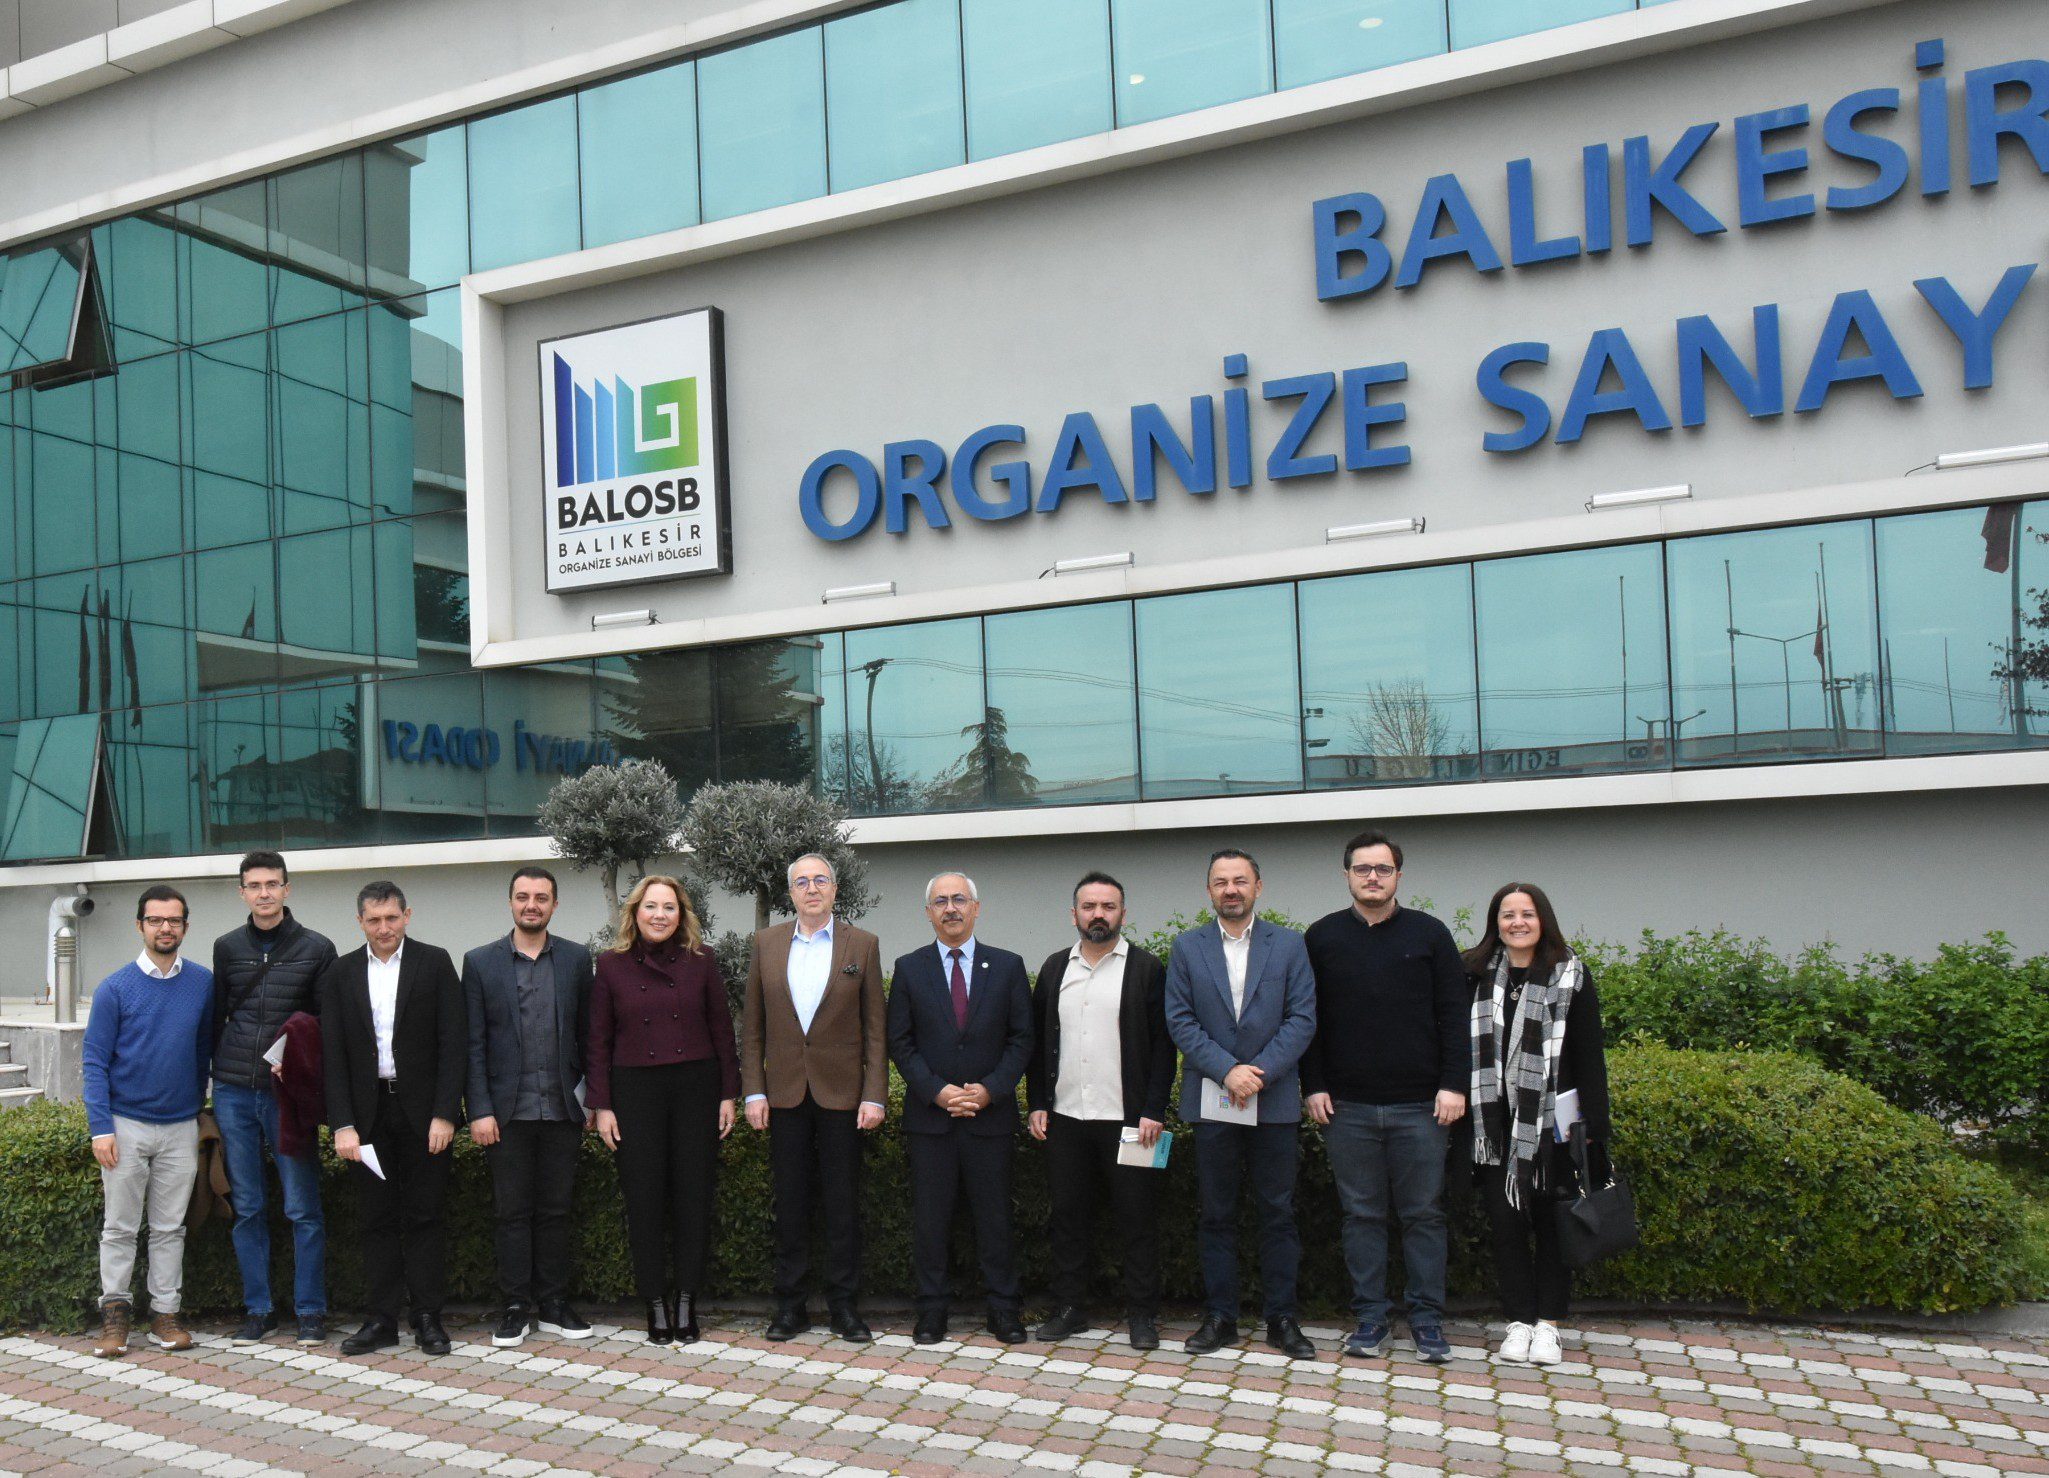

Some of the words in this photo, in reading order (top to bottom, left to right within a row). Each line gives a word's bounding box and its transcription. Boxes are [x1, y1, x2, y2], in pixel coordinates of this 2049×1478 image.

[1312, 38, 2049, 302] BALIKESİR
[799, 353, 1412, 542] ORGANİZE
[1476, 263, 2039, 453] SANAY
[558, 477, 700, 529] BALOSB
[558, 556, 612, 574] ORGANİZE
[615, 551, 653, 567] SANAYİ
[657, 543, 702, 562] BÖLGESİ
[559, 523, 701, 558] BALIKESİR
